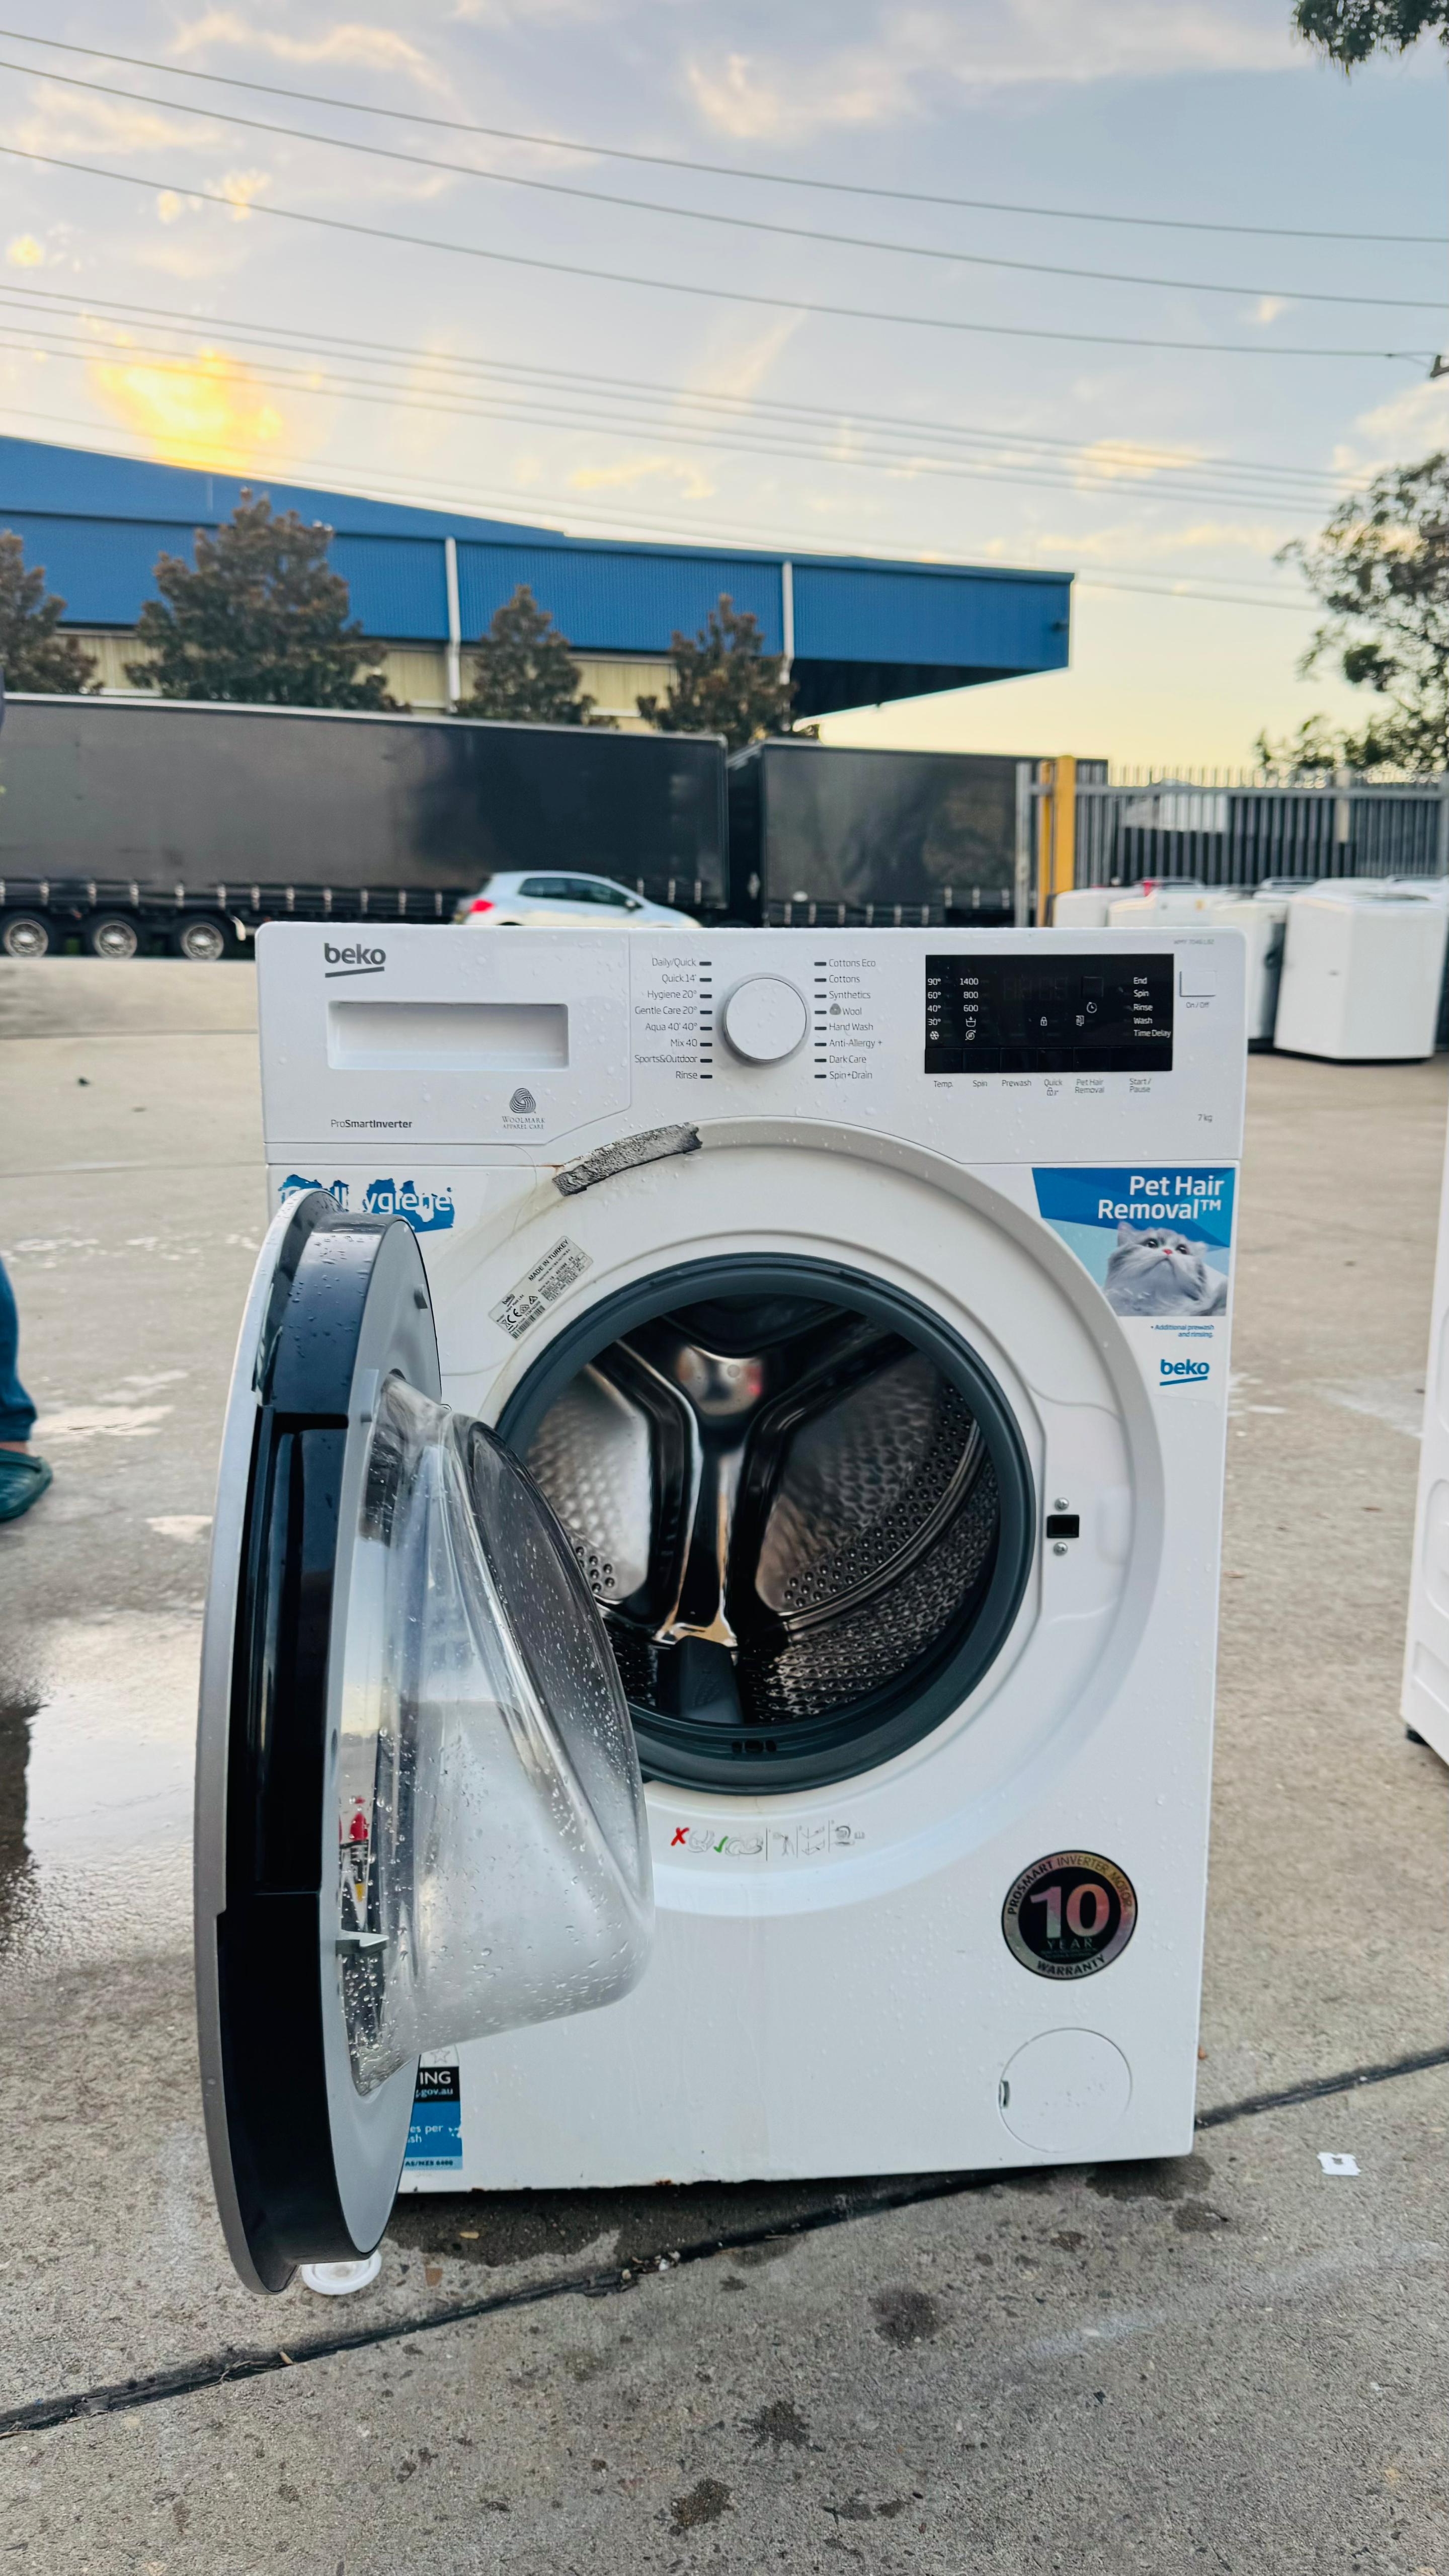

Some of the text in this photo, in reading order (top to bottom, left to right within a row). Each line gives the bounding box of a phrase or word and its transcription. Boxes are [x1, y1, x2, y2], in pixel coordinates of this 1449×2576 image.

[324, 942, 386, 966] beko
[652, 958, 696, 968] Daily/Quick
[829, 959, 876, 967] Cottons Eco
[662, 974, 684, 984] Quick
[829, 975, 860, 983] Cottons
[648, 990, 697, 1000] Hygiene 20°
[829, 991, 871, 1001] Synthetics
[1134, 989, 1150, 998] Spin
[635, 1006, 697, 1014] Gentle Care 20°
[842, 1007, 862, 1015] Wool
[645, 1023, 666, 1032] Aqua
[829, 1022, 873, 1030] Hand Wash
[1151, 1029, 1171, 1038] Delay
[829, 1039, 875, 1049] Anti-Allergy
[635, 1055, 698, 1065] Sports&Outdoor
[829, 1055, 866, 1063] Dark Care
[676, 1071, 698, 1079] Rinse
[829, 1071, 873, 1080] Spin+Drain
[973, 1080, 988, 1088] Spin
[1044, 1079, 1063, 1087] Quick
[331, 1119, 413, 1129] ProSmartInverter
[1130, 1175, 1225, 1196] Pet Hair
[528, 1266, 544, 1281] MADE
[543, 1259, 550, 1267] IN
[548, 1239, 569, 1260] TURKEY
[1160, 1359, 1210, 1375] beko
[1007, 1855, 1133, 1915] PROSMART INVERTER MOTOR
[1030, 1883, 1110, 1938] 10
[1037, 1954, 1105, 1976] WARRANTY
[425, 2125, 443, 2135] per
